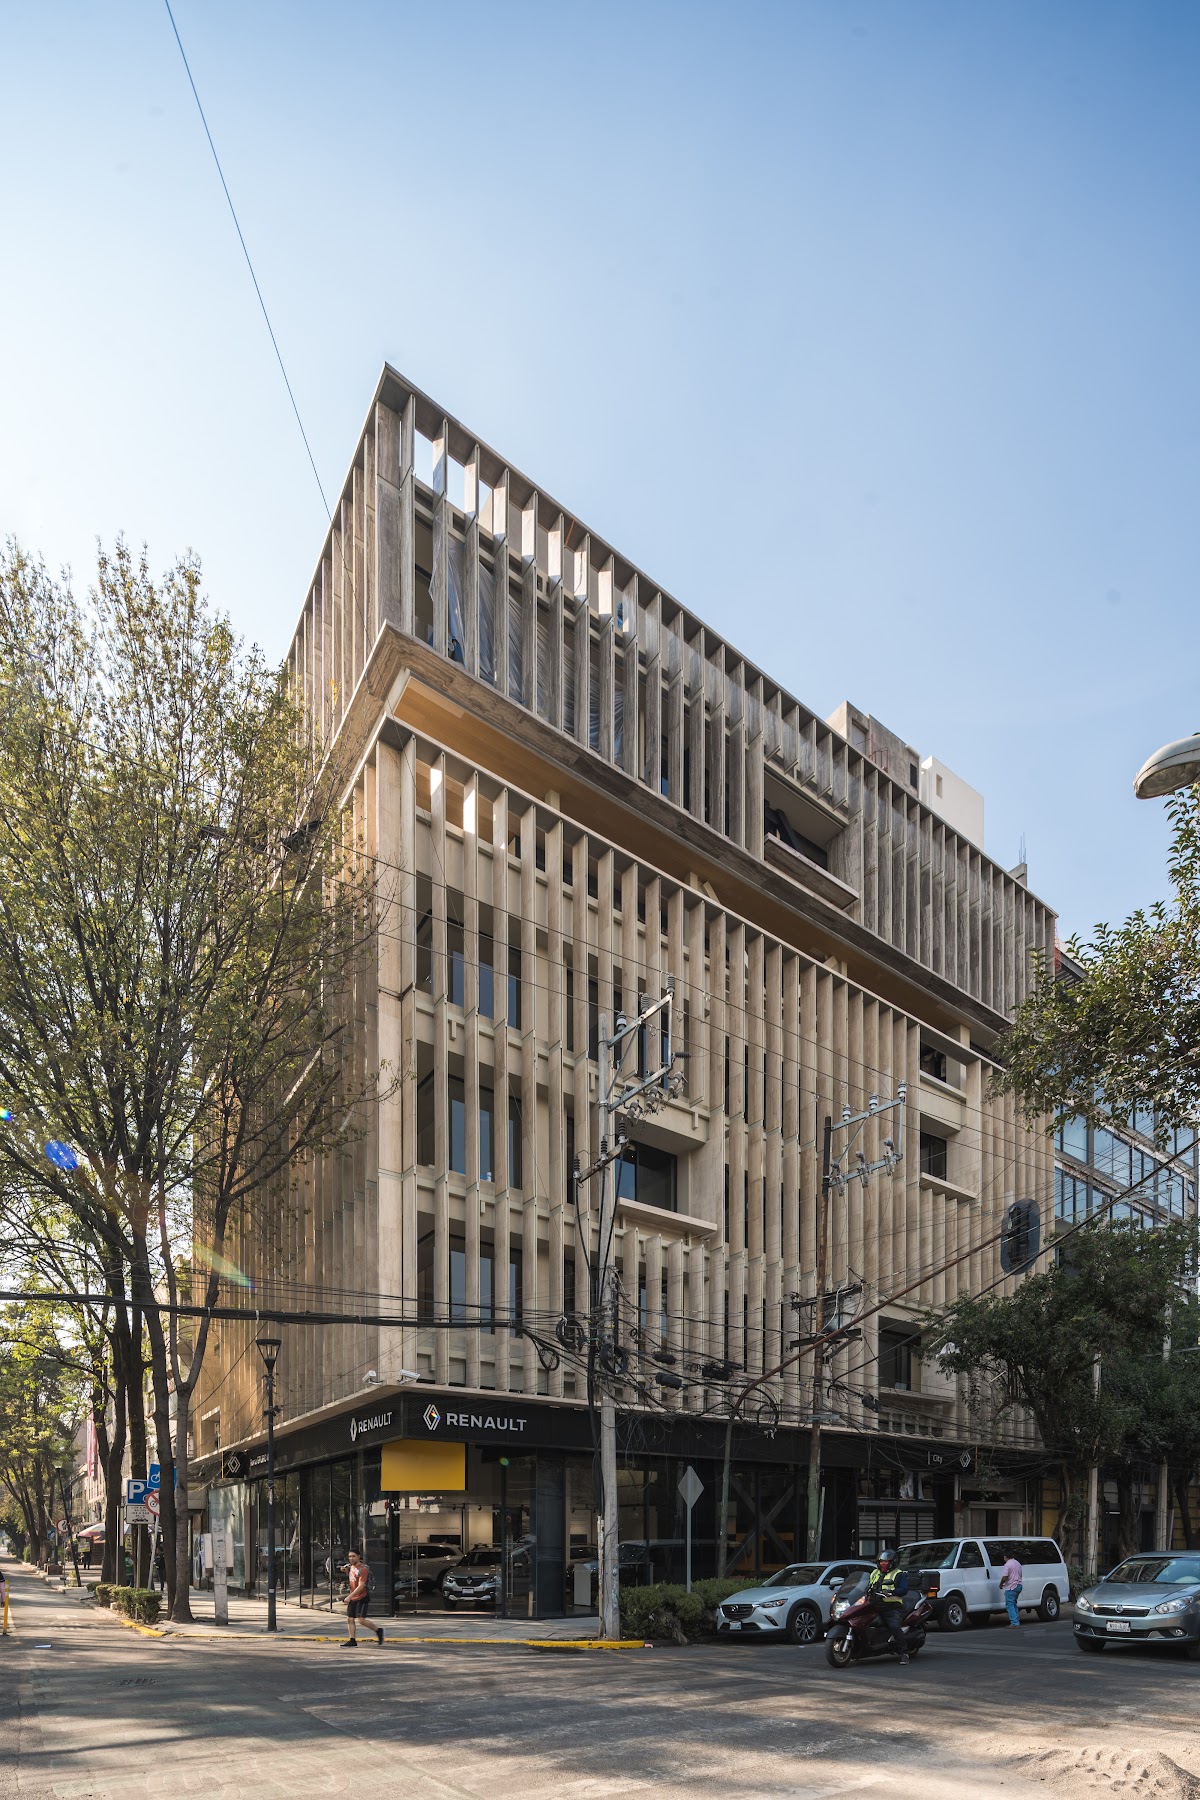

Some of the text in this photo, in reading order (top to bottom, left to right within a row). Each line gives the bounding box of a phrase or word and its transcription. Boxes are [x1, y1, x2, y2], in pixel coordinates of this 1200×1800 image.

[358, 1411, 393, 1433] RENAULT
[446, 1412, 527, 1432] RENAULT
[932, 1454, 944, 1464] City
[129, 1482, 144, 1499] P
